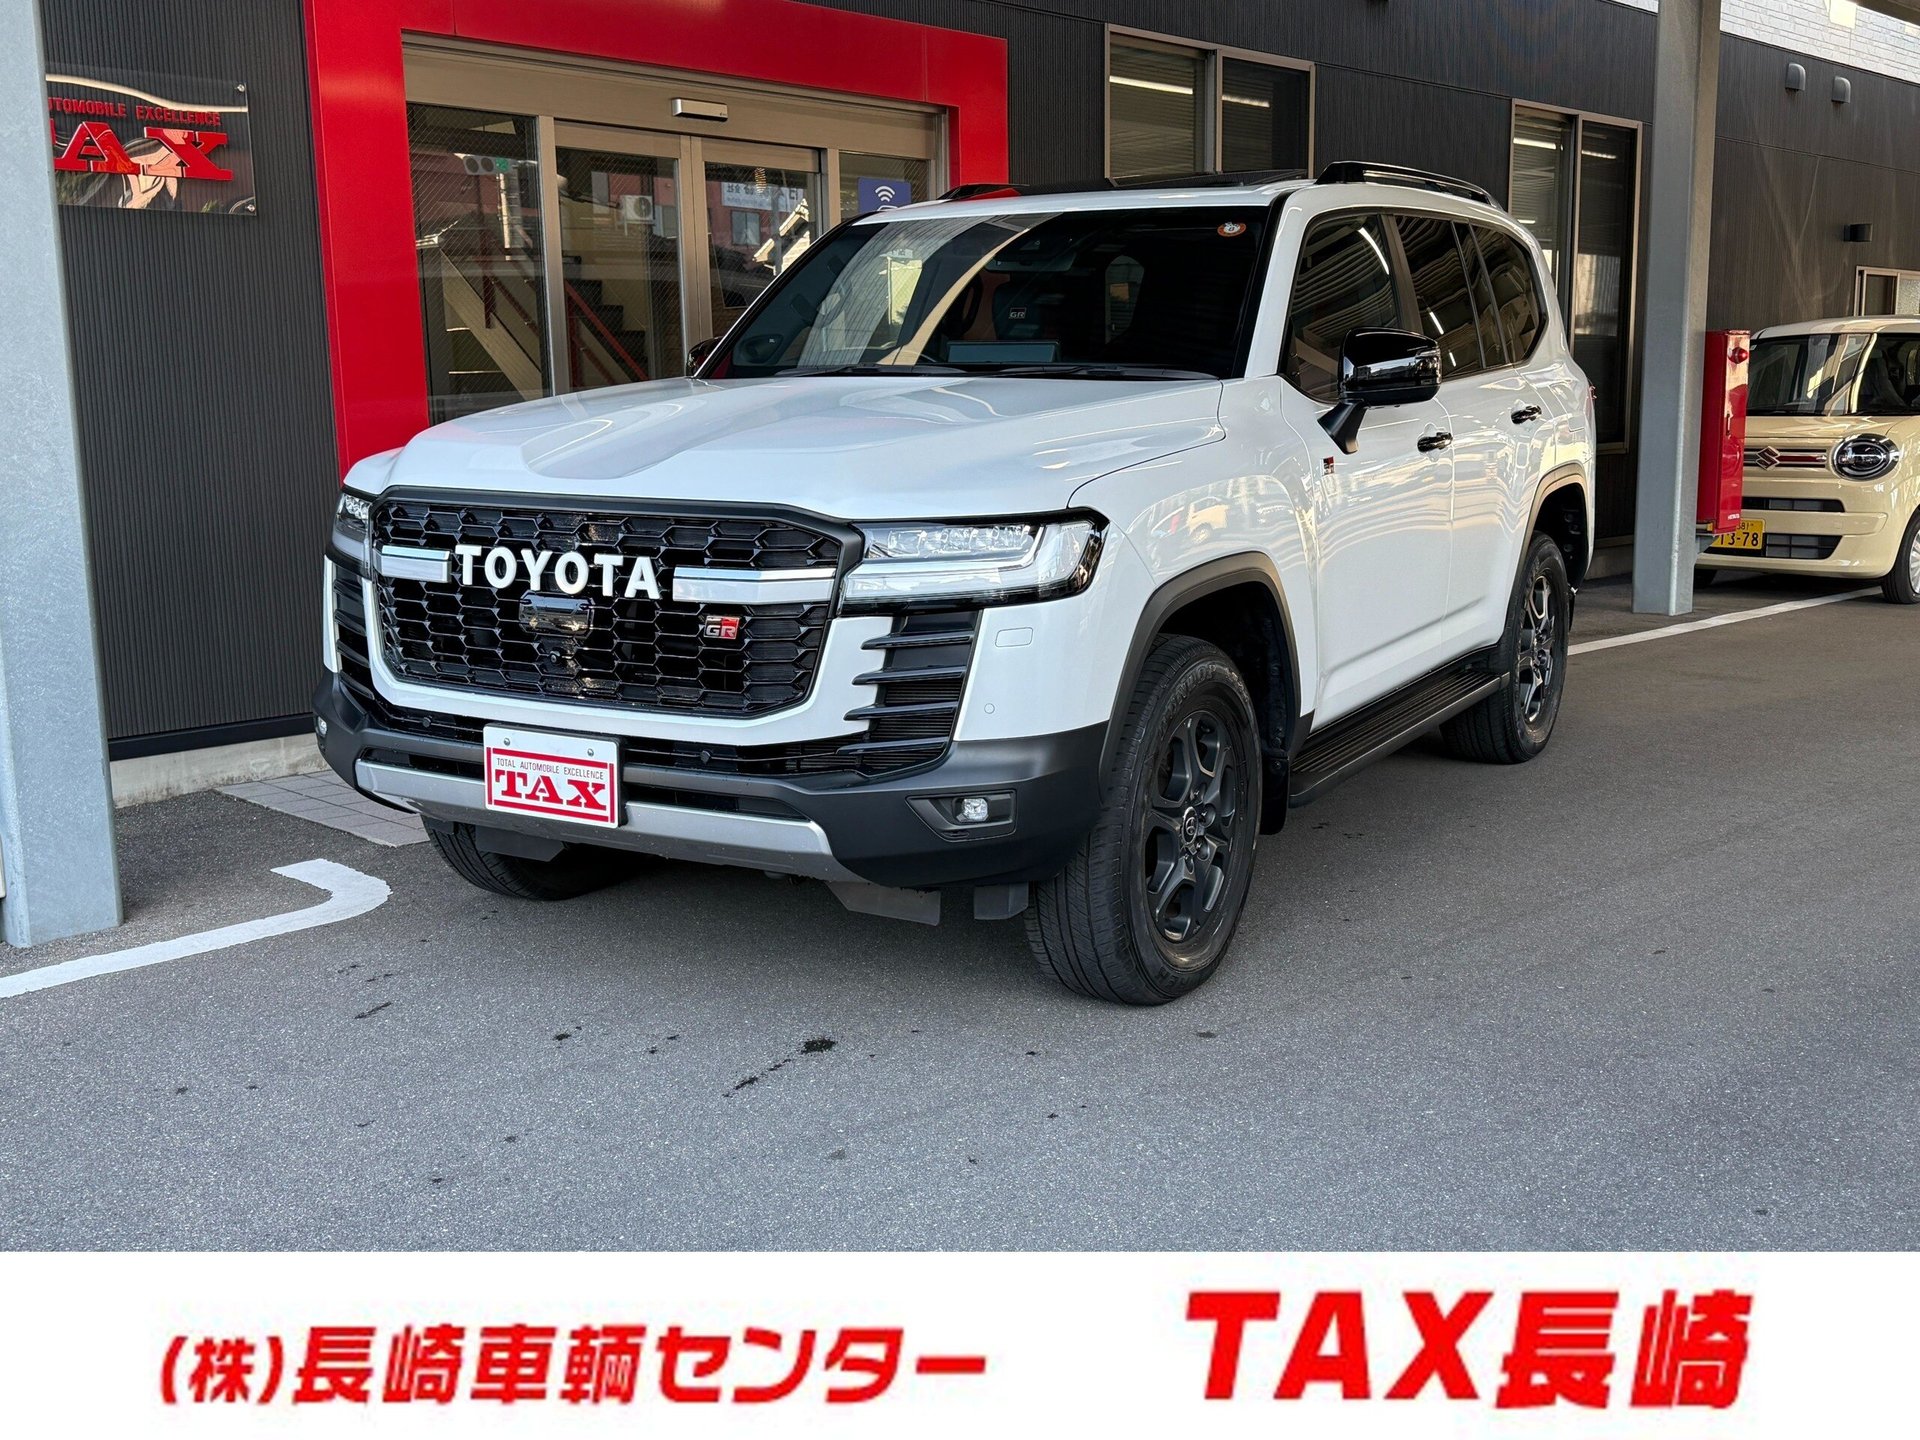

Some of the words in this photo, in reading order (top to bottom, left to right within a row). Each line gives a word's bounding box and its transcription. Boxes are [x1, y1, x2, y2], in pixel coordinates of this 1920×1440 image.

[136, 105, 221, 127] EXCELLENCE
[51, 118, 234, 181] AX
[455, 544, 660, 600] TOYOTA
[705, 622, 738, 639] GR
[496, 757, 516, 769] TOTAL
[520, 760, 560, 775] AUTOMOBILE
[563, 766, 604, 780] EXCELLENCE
[495, 769, 607, 811] TAX
